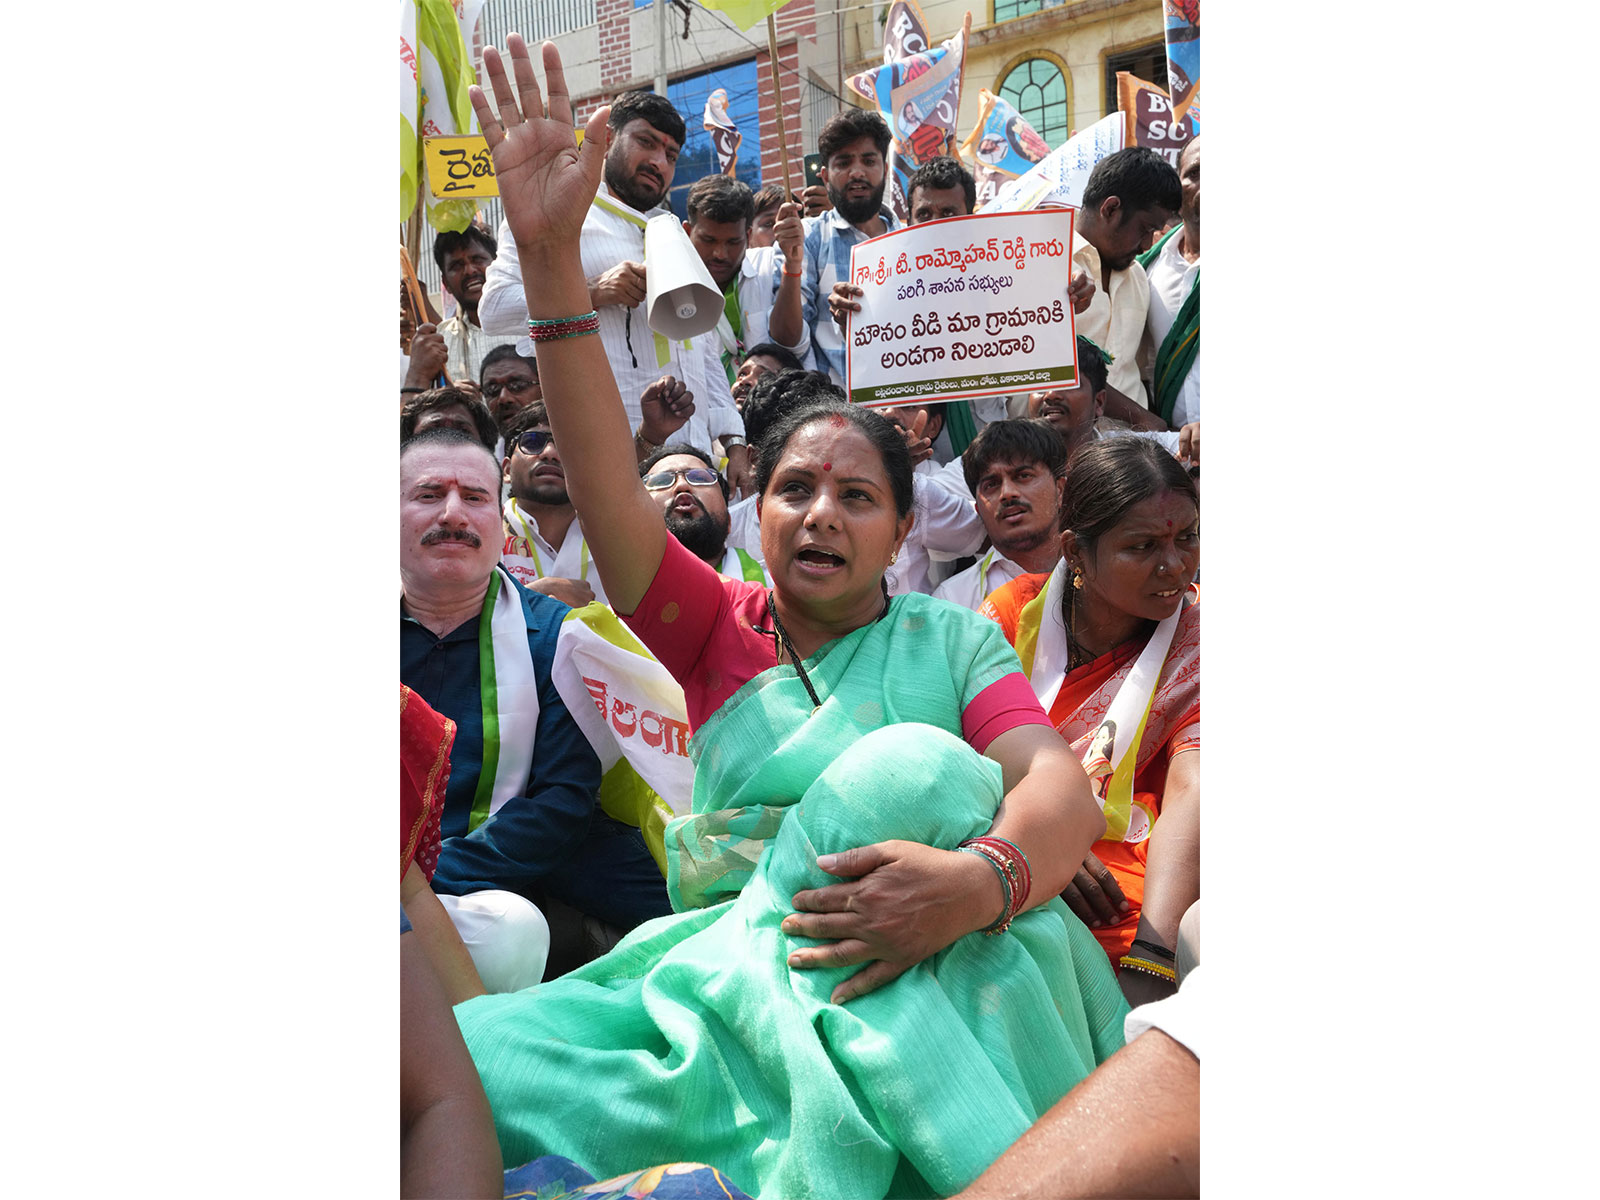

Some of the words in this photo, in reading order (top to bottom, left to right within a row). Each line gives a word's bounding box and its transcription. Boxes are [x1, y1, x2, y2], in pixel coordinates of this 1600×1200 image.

[892, 10, 928, 54] BC
[1147, 119, 1188, 141] SC
[896, 252, 911, 275] టి.
[915, 238, 998, 272] రామ్మోహన్
[1003, 236, 1026, 270] రెడ్డి
[1029, 238, 1064, 259] గారు
[897, 279, 926, 300] పరిగి
[928, 277, 965, 294] శాసన
[968, 273, 1013, 295] సభ్యులు
[855, 322, 907, 347] మౌనం
[911, 311, 942, 338] వీడి
[947, 313, 981, 333] మా
[985, 300, 1064, 336] గ్రామానికి
[881, 346, 946, 369] అండగా
[951, 334, 1035, 360] నిలబడాలి
